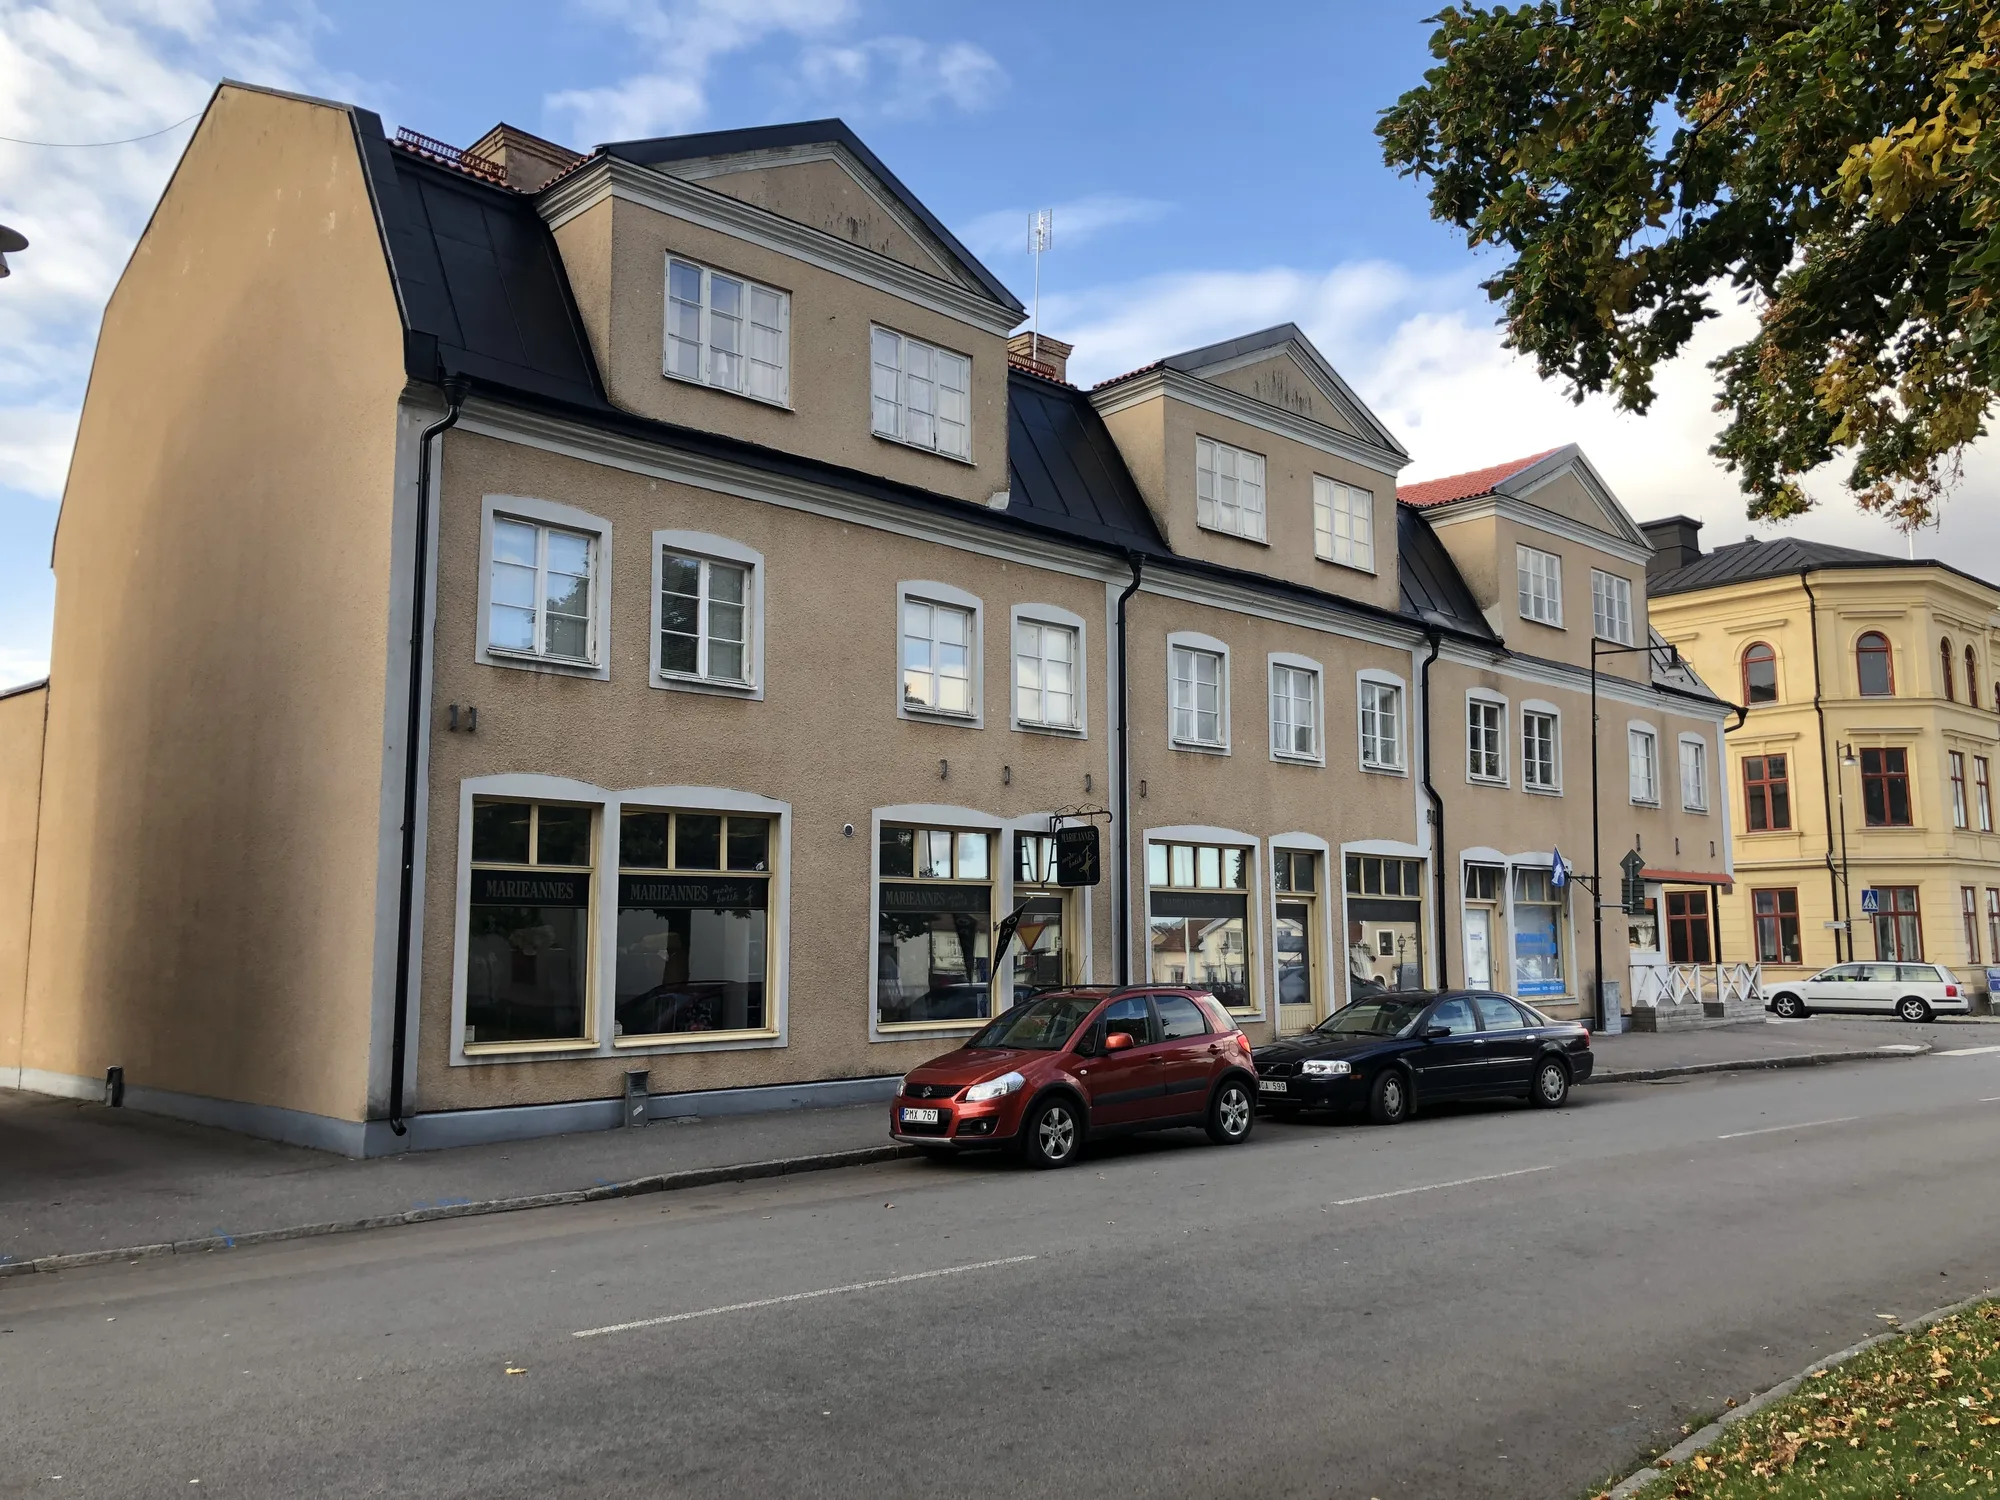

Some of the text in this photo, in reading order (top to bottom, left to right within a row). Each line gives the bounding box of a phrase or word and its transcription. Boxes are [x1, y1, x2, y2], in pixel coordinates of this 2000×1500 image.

[486, 879, 574, 900] MARIEANNES
[630, 884, 709, 902] MARIEANNES
[885, 890, 946, 906] MARIEANNES
[1272, 1081, 1286, 1091] 599
[905, 1109, 937, 1121] PMX 767
